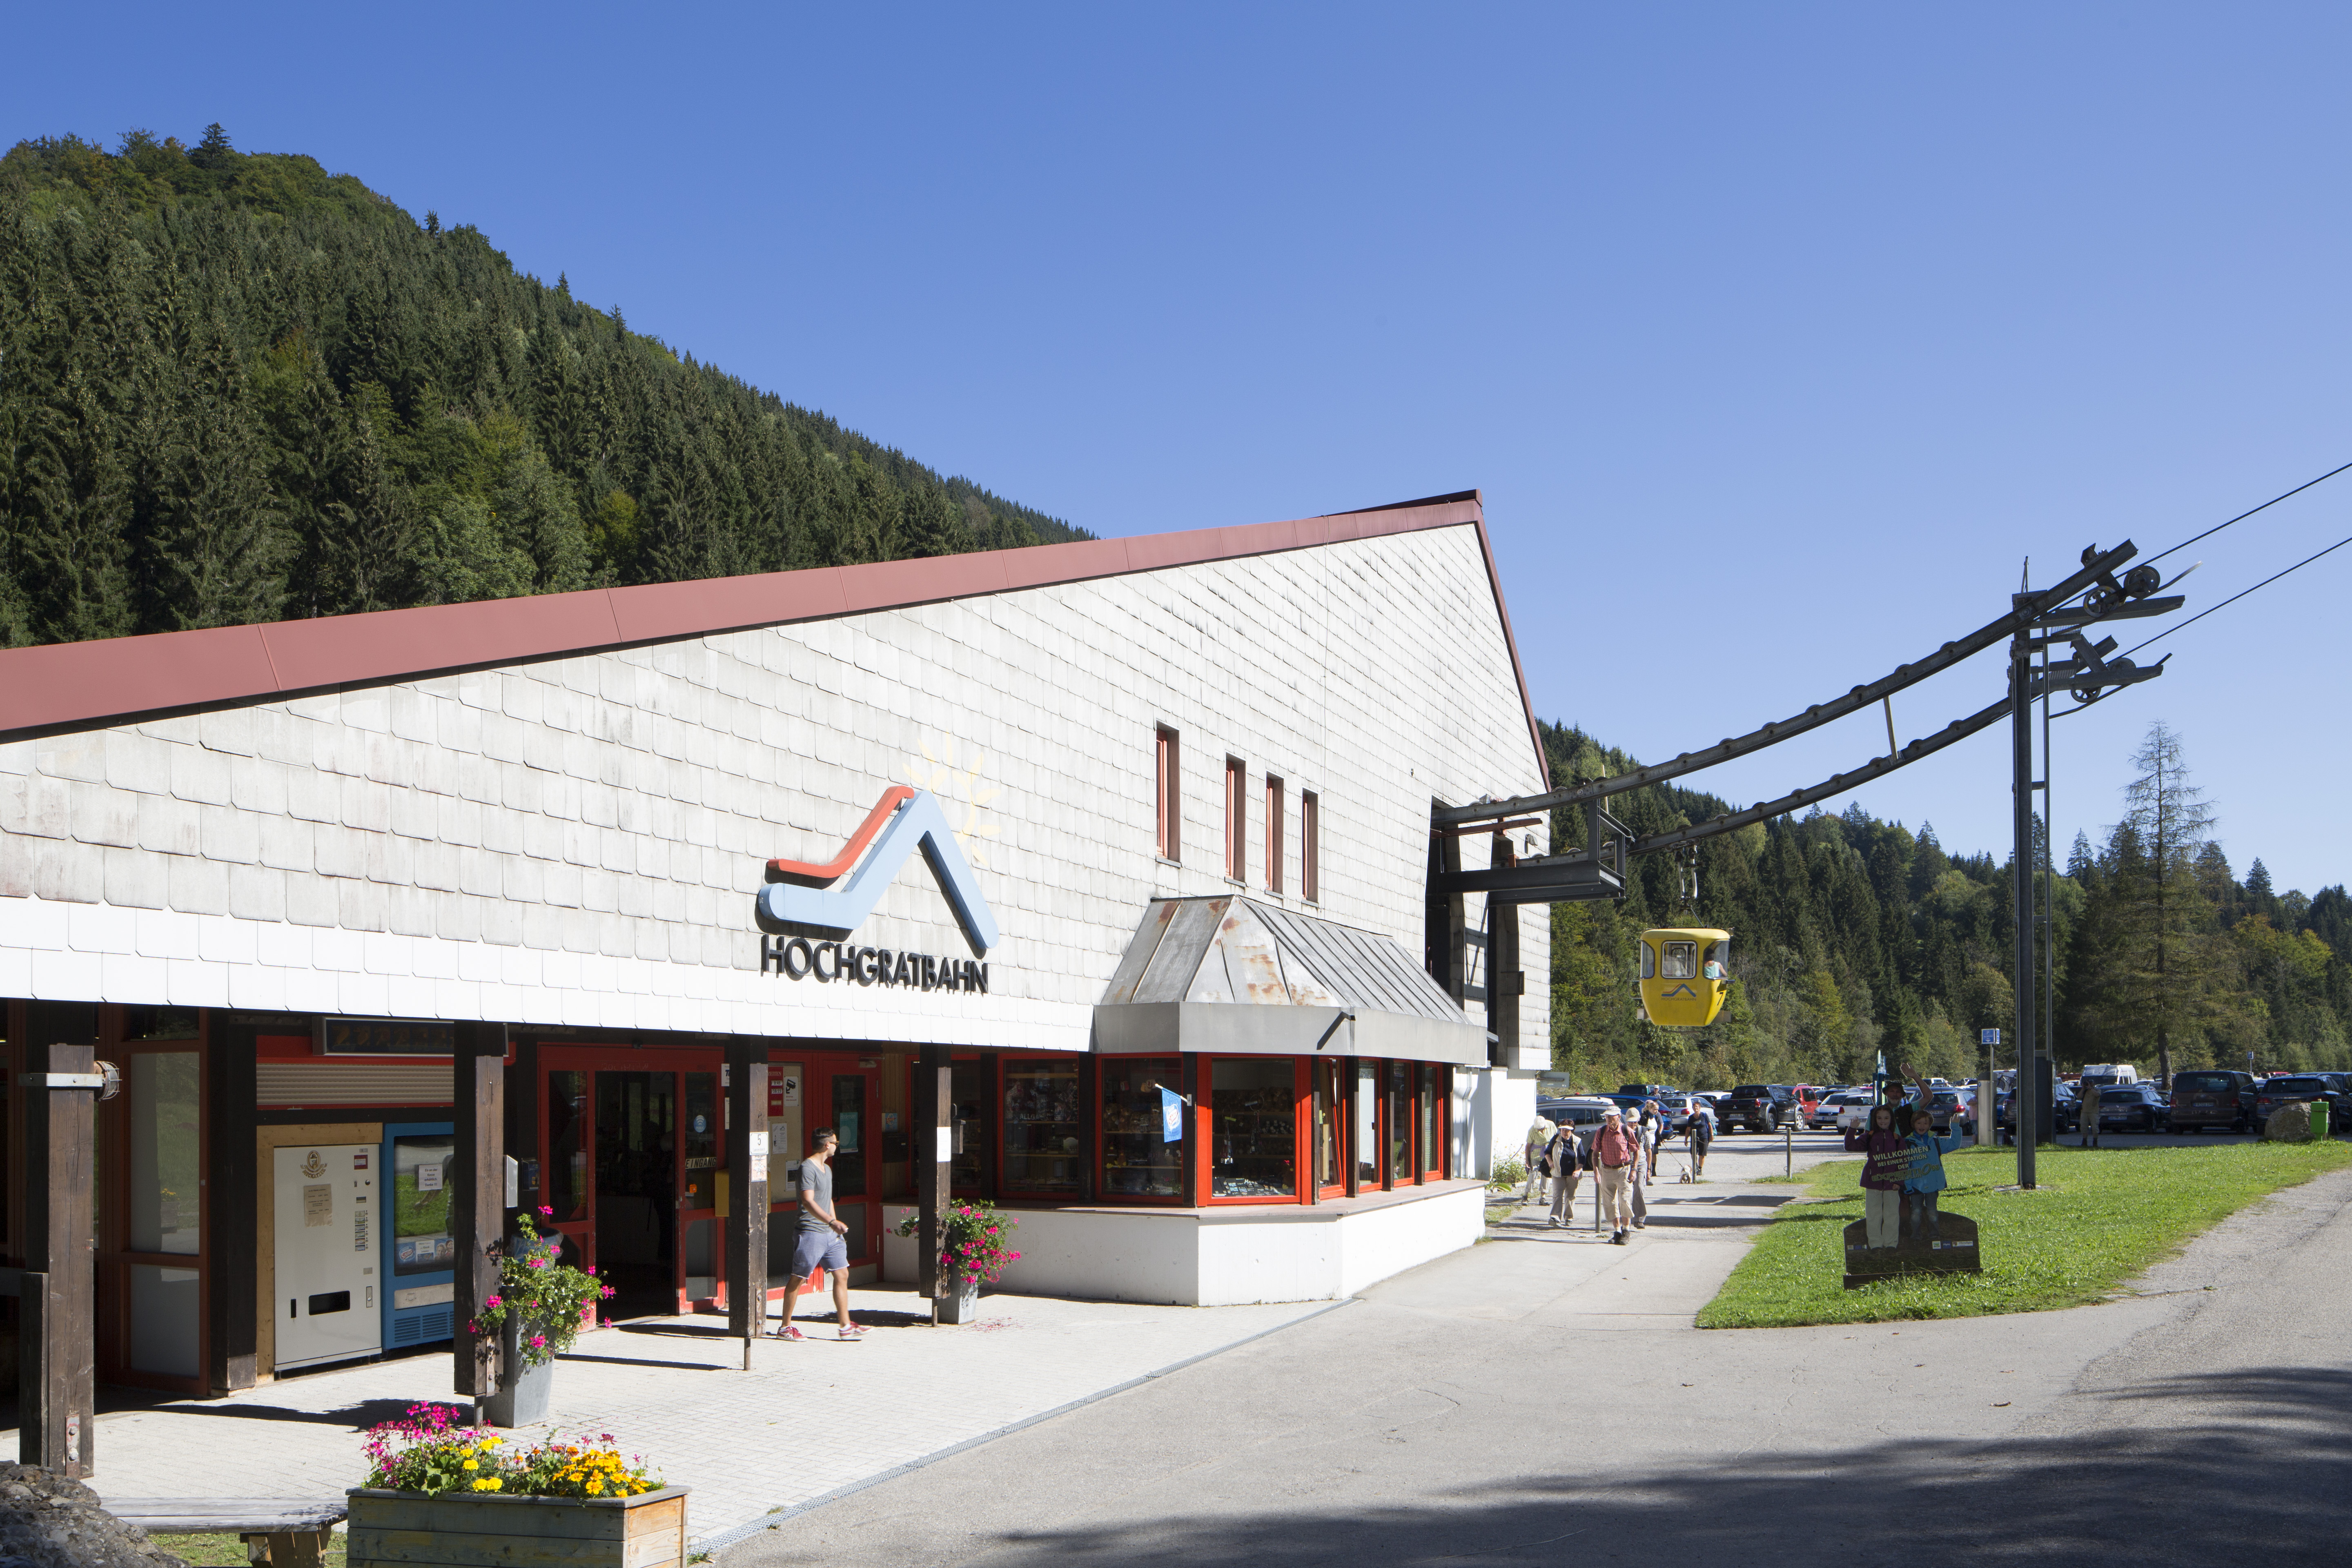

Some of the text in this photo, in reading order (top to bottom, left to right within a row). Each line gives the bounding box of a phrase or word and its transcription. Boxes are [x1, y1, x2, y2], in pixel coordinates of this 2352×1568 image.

[761, 934, 989, 994] HOCHGRATBAHN
[1717, 992, 1724, 1006] 7
[757, 1134, 761, 1145] 5
[1873, 1145, 1929, 1161] WILLKOMMEN
[1904, 1154, 1927, 1163] STATION
[685, 1157, 716, 1168] EINGANG
